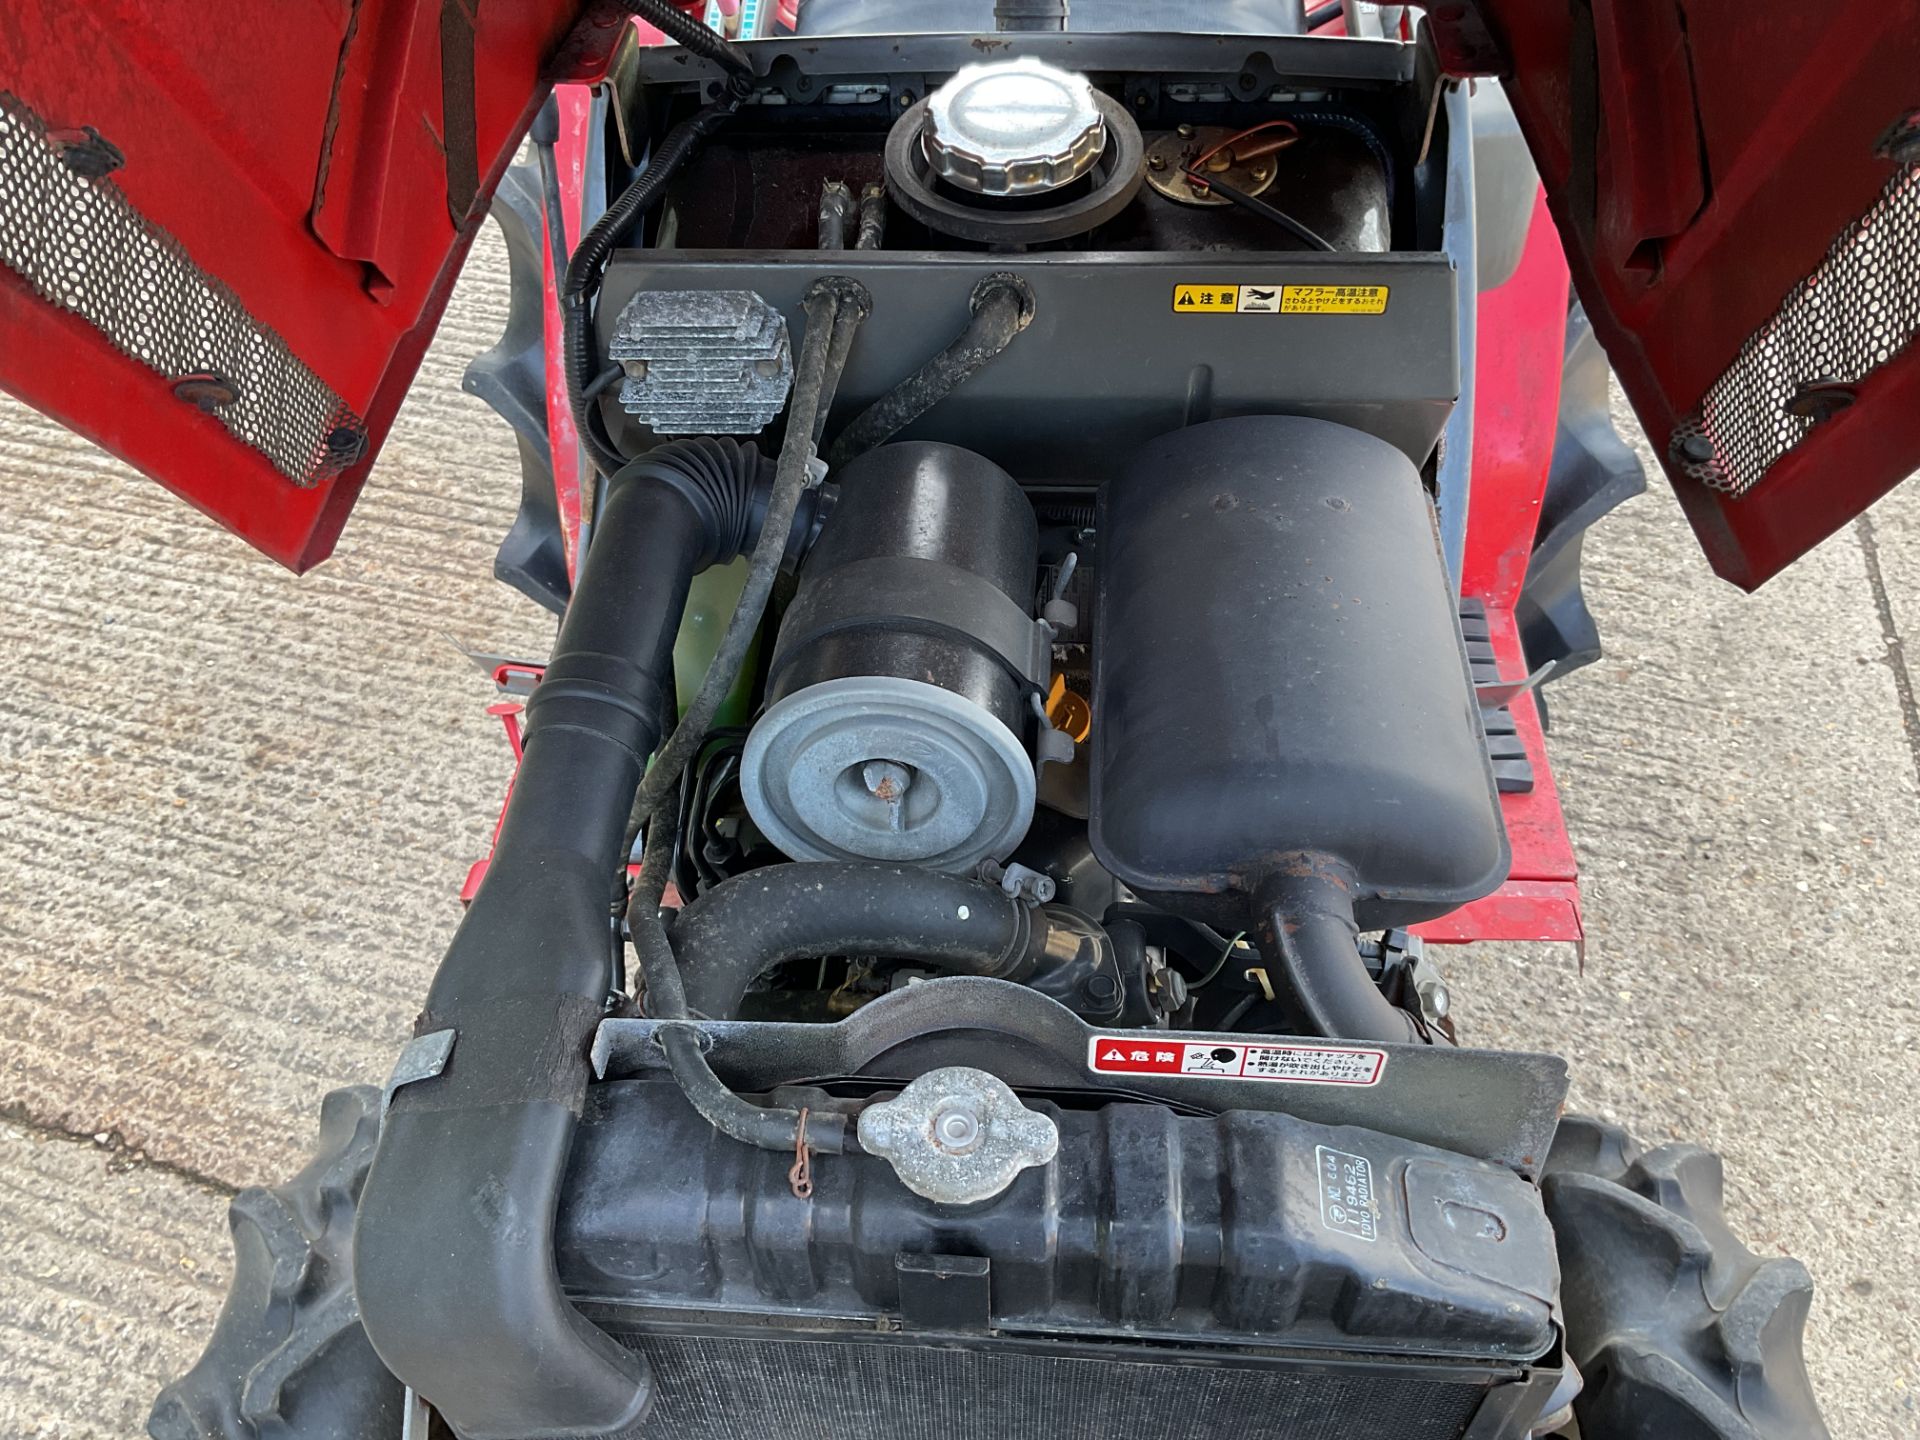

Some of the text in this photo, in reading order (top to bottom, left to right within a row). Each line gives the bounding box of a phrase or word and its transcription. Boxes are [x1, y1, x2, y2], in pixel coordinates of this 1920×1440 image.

[1199, 292, 1234, 305] 注意
[1293, 287, 1379, 297] マフラー高温注意
[1130, 1050, 1176, 1063] 危険
[1344, 1163, 1360, 1225] 119462
[1355, 1160, 1372, 1236] TOYO RADIATOR
